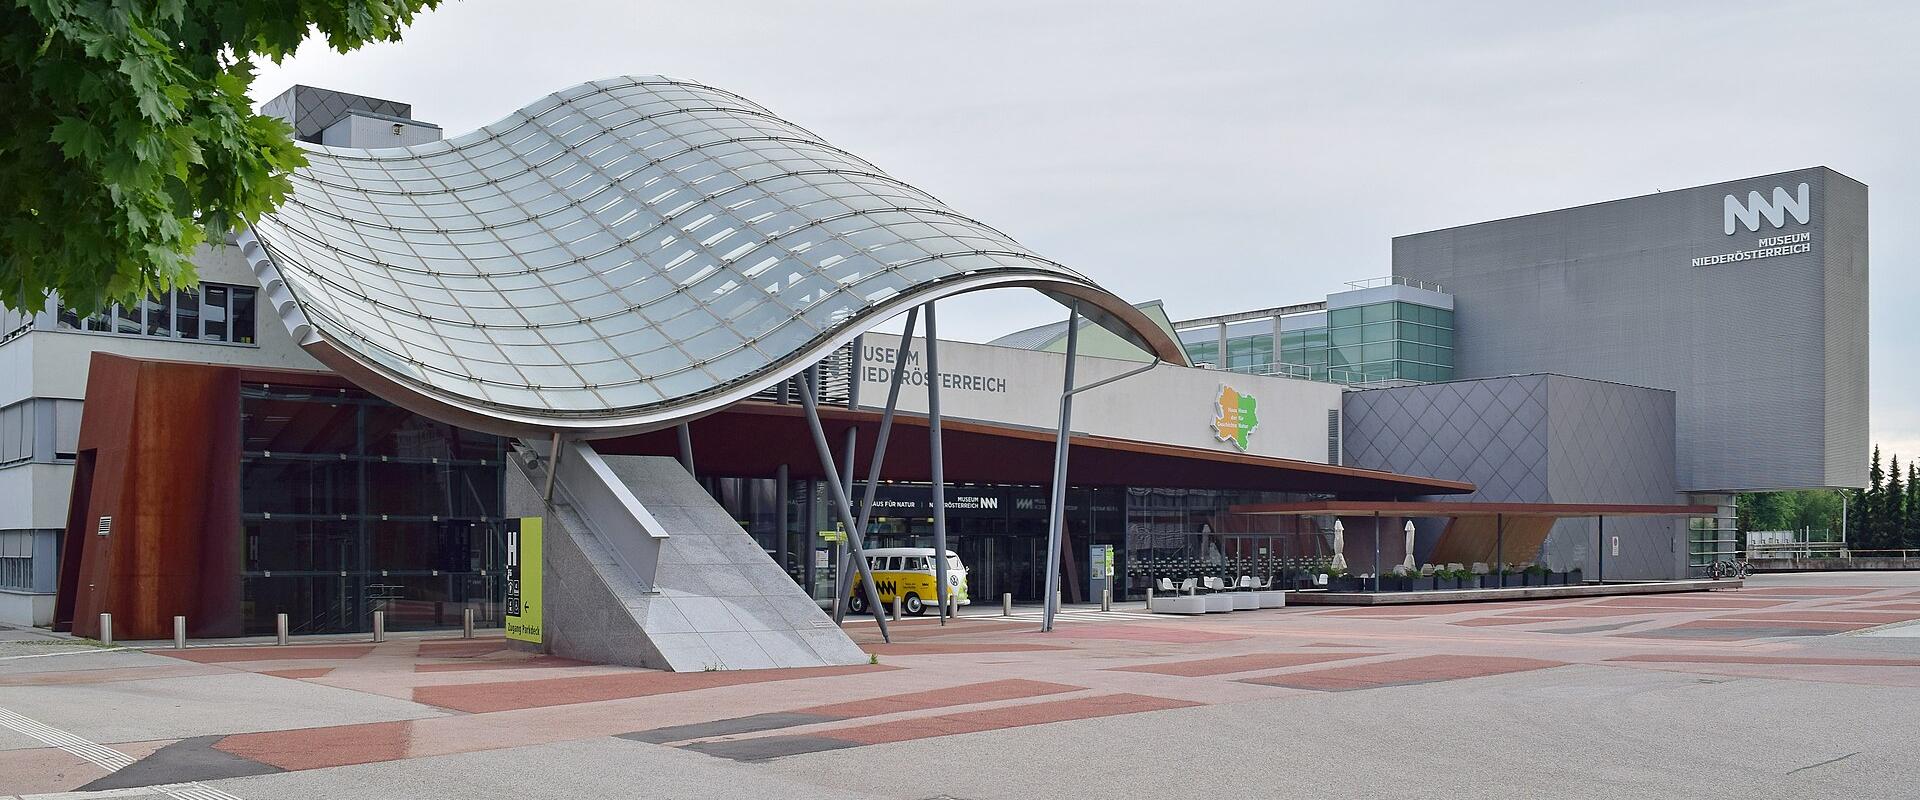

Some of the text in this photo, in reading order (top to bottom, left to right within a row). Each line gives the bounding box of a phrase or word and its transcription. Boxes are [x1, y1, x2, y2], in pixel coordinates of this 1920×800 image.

[1758, 232, 1810, 248] MUSEUM
[1691, 243, 1811, 267] NIEDERÖSTERREICH
[863, 346, 919, 366] USEM
[862, 366, 1006, 393] IEDRÖSERREICH
[508, 532, 516, 565] H
[507, 622, 540, 636] Zugang Parkdeck
